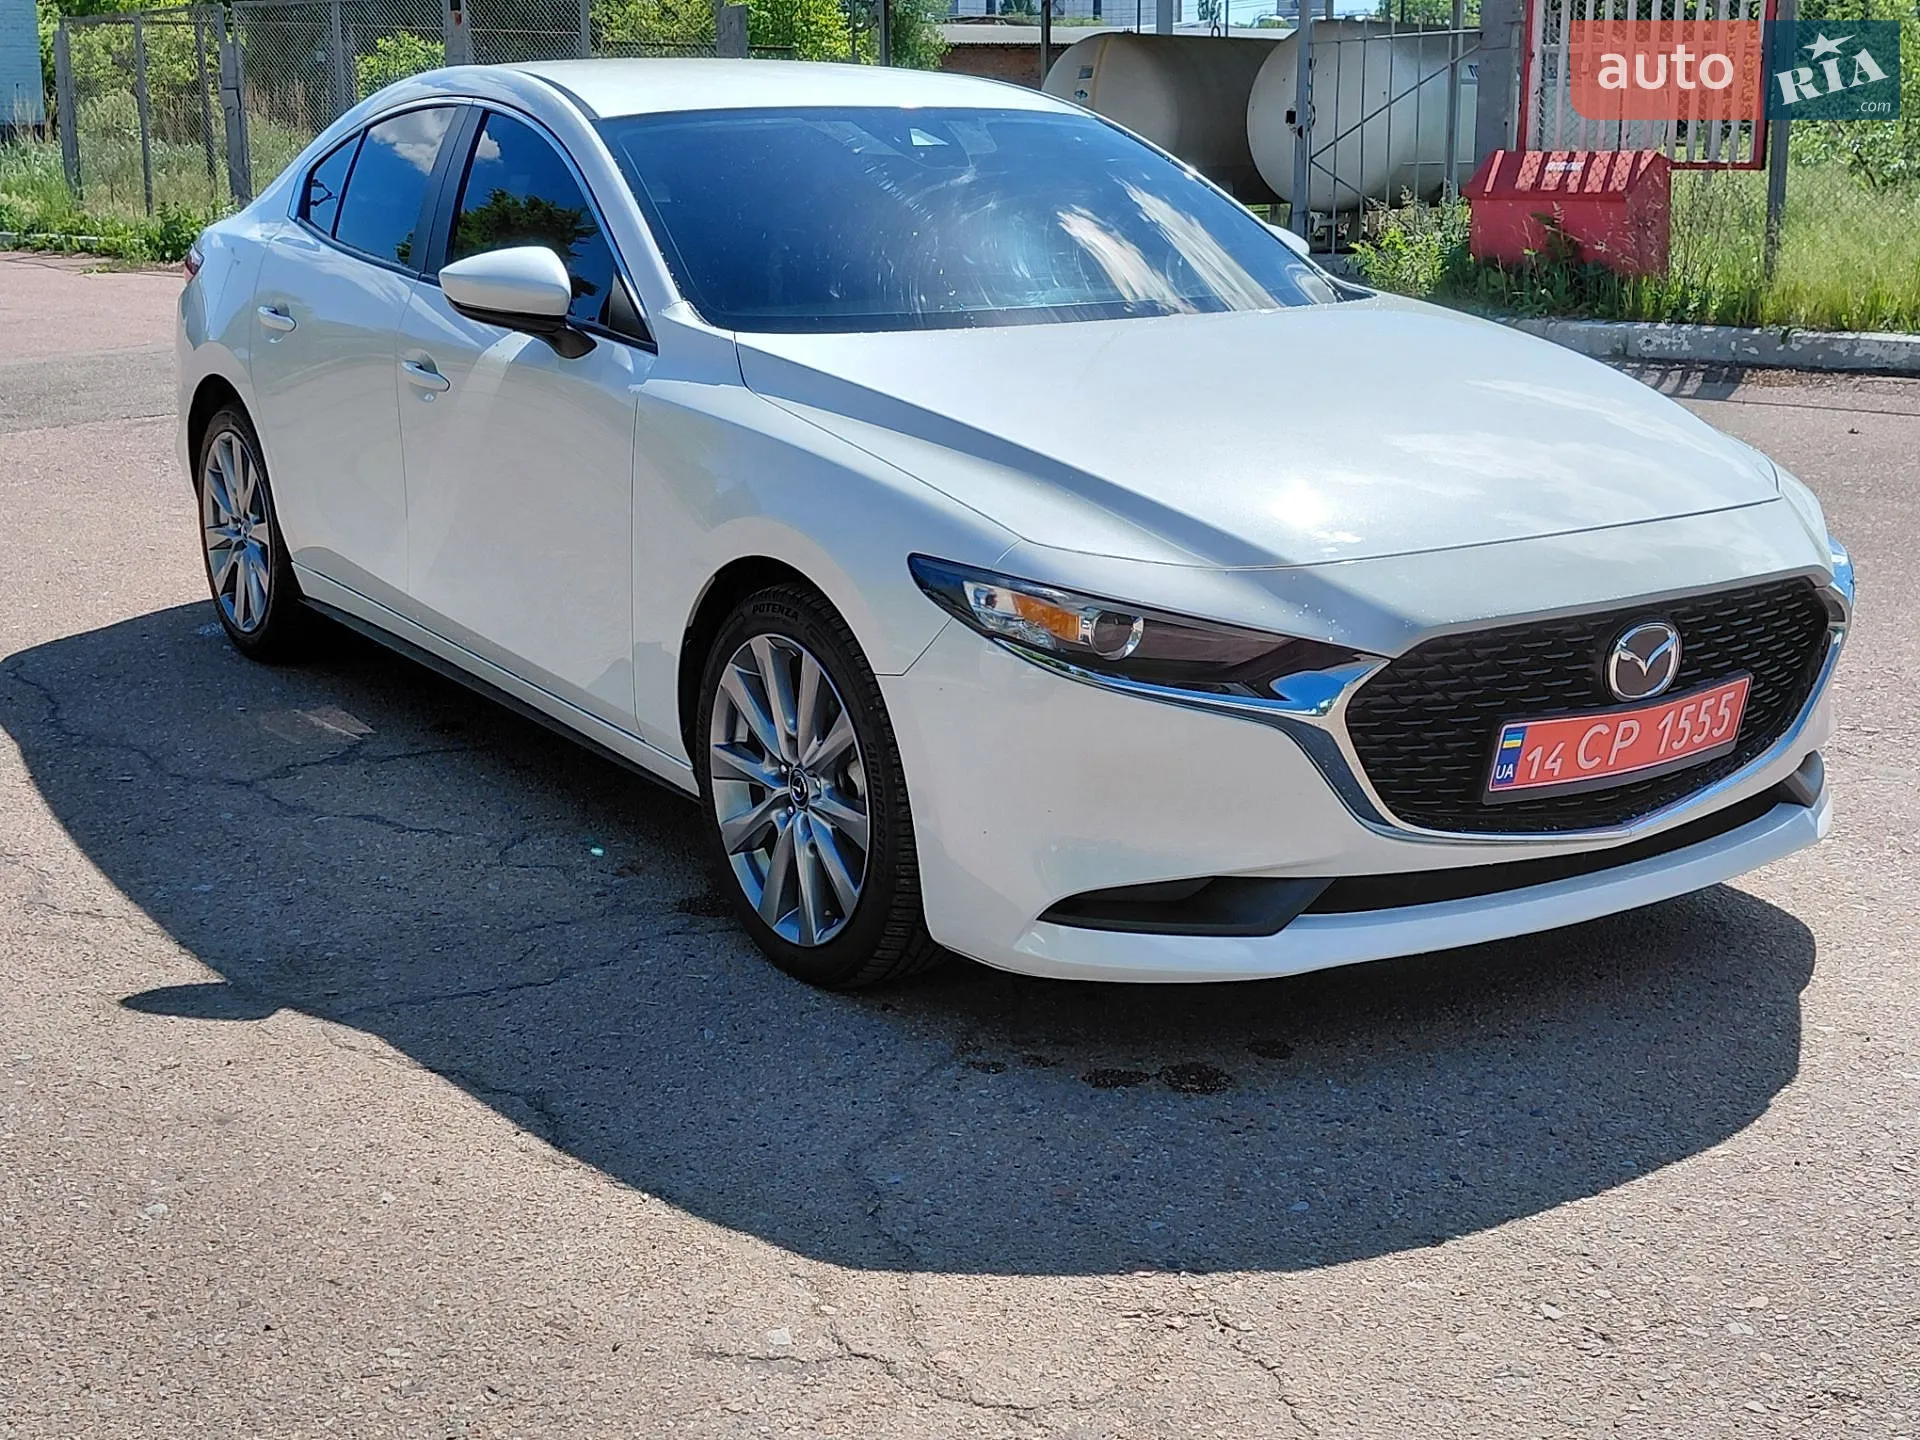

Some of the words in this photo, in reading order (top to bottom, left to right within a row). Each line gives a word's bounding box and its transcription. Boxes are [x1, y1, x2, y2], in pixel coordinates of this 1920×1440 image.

[751, 602, 799, 623] POTENZA
[1526, 742, 1565, 779] 14
[1577, 719, 1641, 767] CP
[1657, 691, 1735, 755] 1555
[1496, 764, 1515, 779] UA
